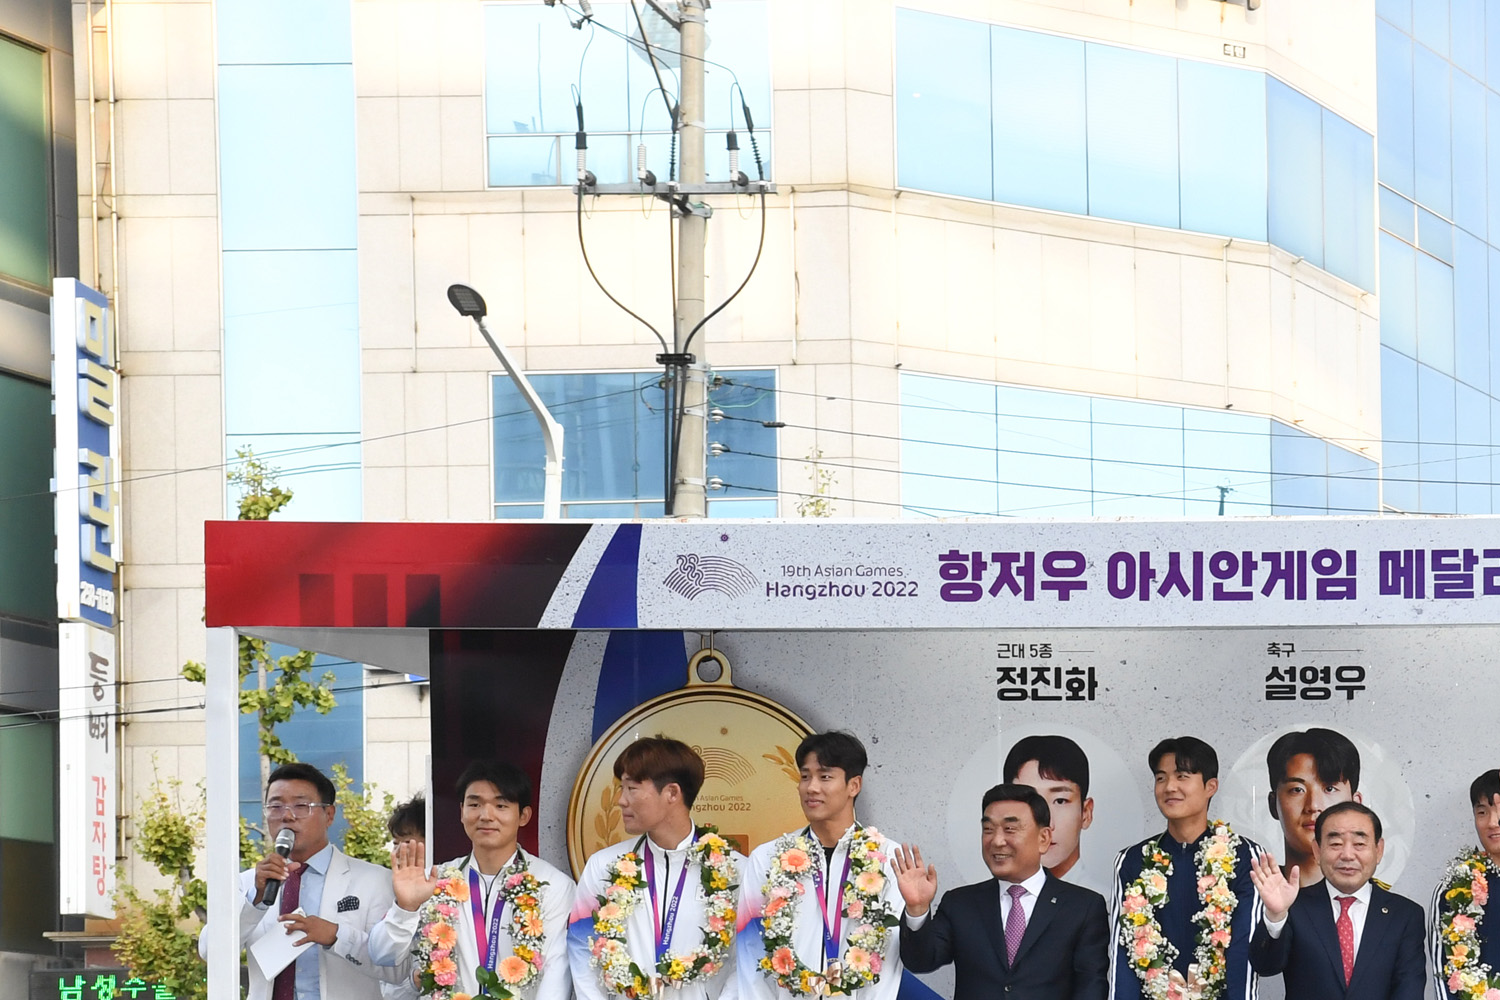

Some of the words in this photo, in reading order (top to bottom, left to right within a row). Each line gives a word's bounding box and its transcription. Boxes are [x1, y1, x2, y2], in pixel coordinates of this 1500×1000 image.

[781, 565, 811, 577] 19th
[814, 565, 853, 577] Asian
[855, 565, 903, 577] Games
[936, 549, 1090, 605] 항저우
[1107, 547, 1358, 602] 아시안게임
[766, 581, 865, 600] Hangzhou
[871, 581, 919, 597] 2022
[996, 643, 1025, 659] 근대
[1029, 643, 1053, 659] 5종
[1266, 643, 1296, 658] 축구
[996, 666, 1098, 703] 정진화
[1265, 664, 1367, 701] 설영우
[728, 803, 751, 811] 2022
[91, 776, 107, 896] 감자탕
[491, 917, 499, 934] 2022
[662, 912, 675, 945] Hangzhou
[670, 895, 679, 911] 2022
[487, 935, 497, 969] Hangzhou
